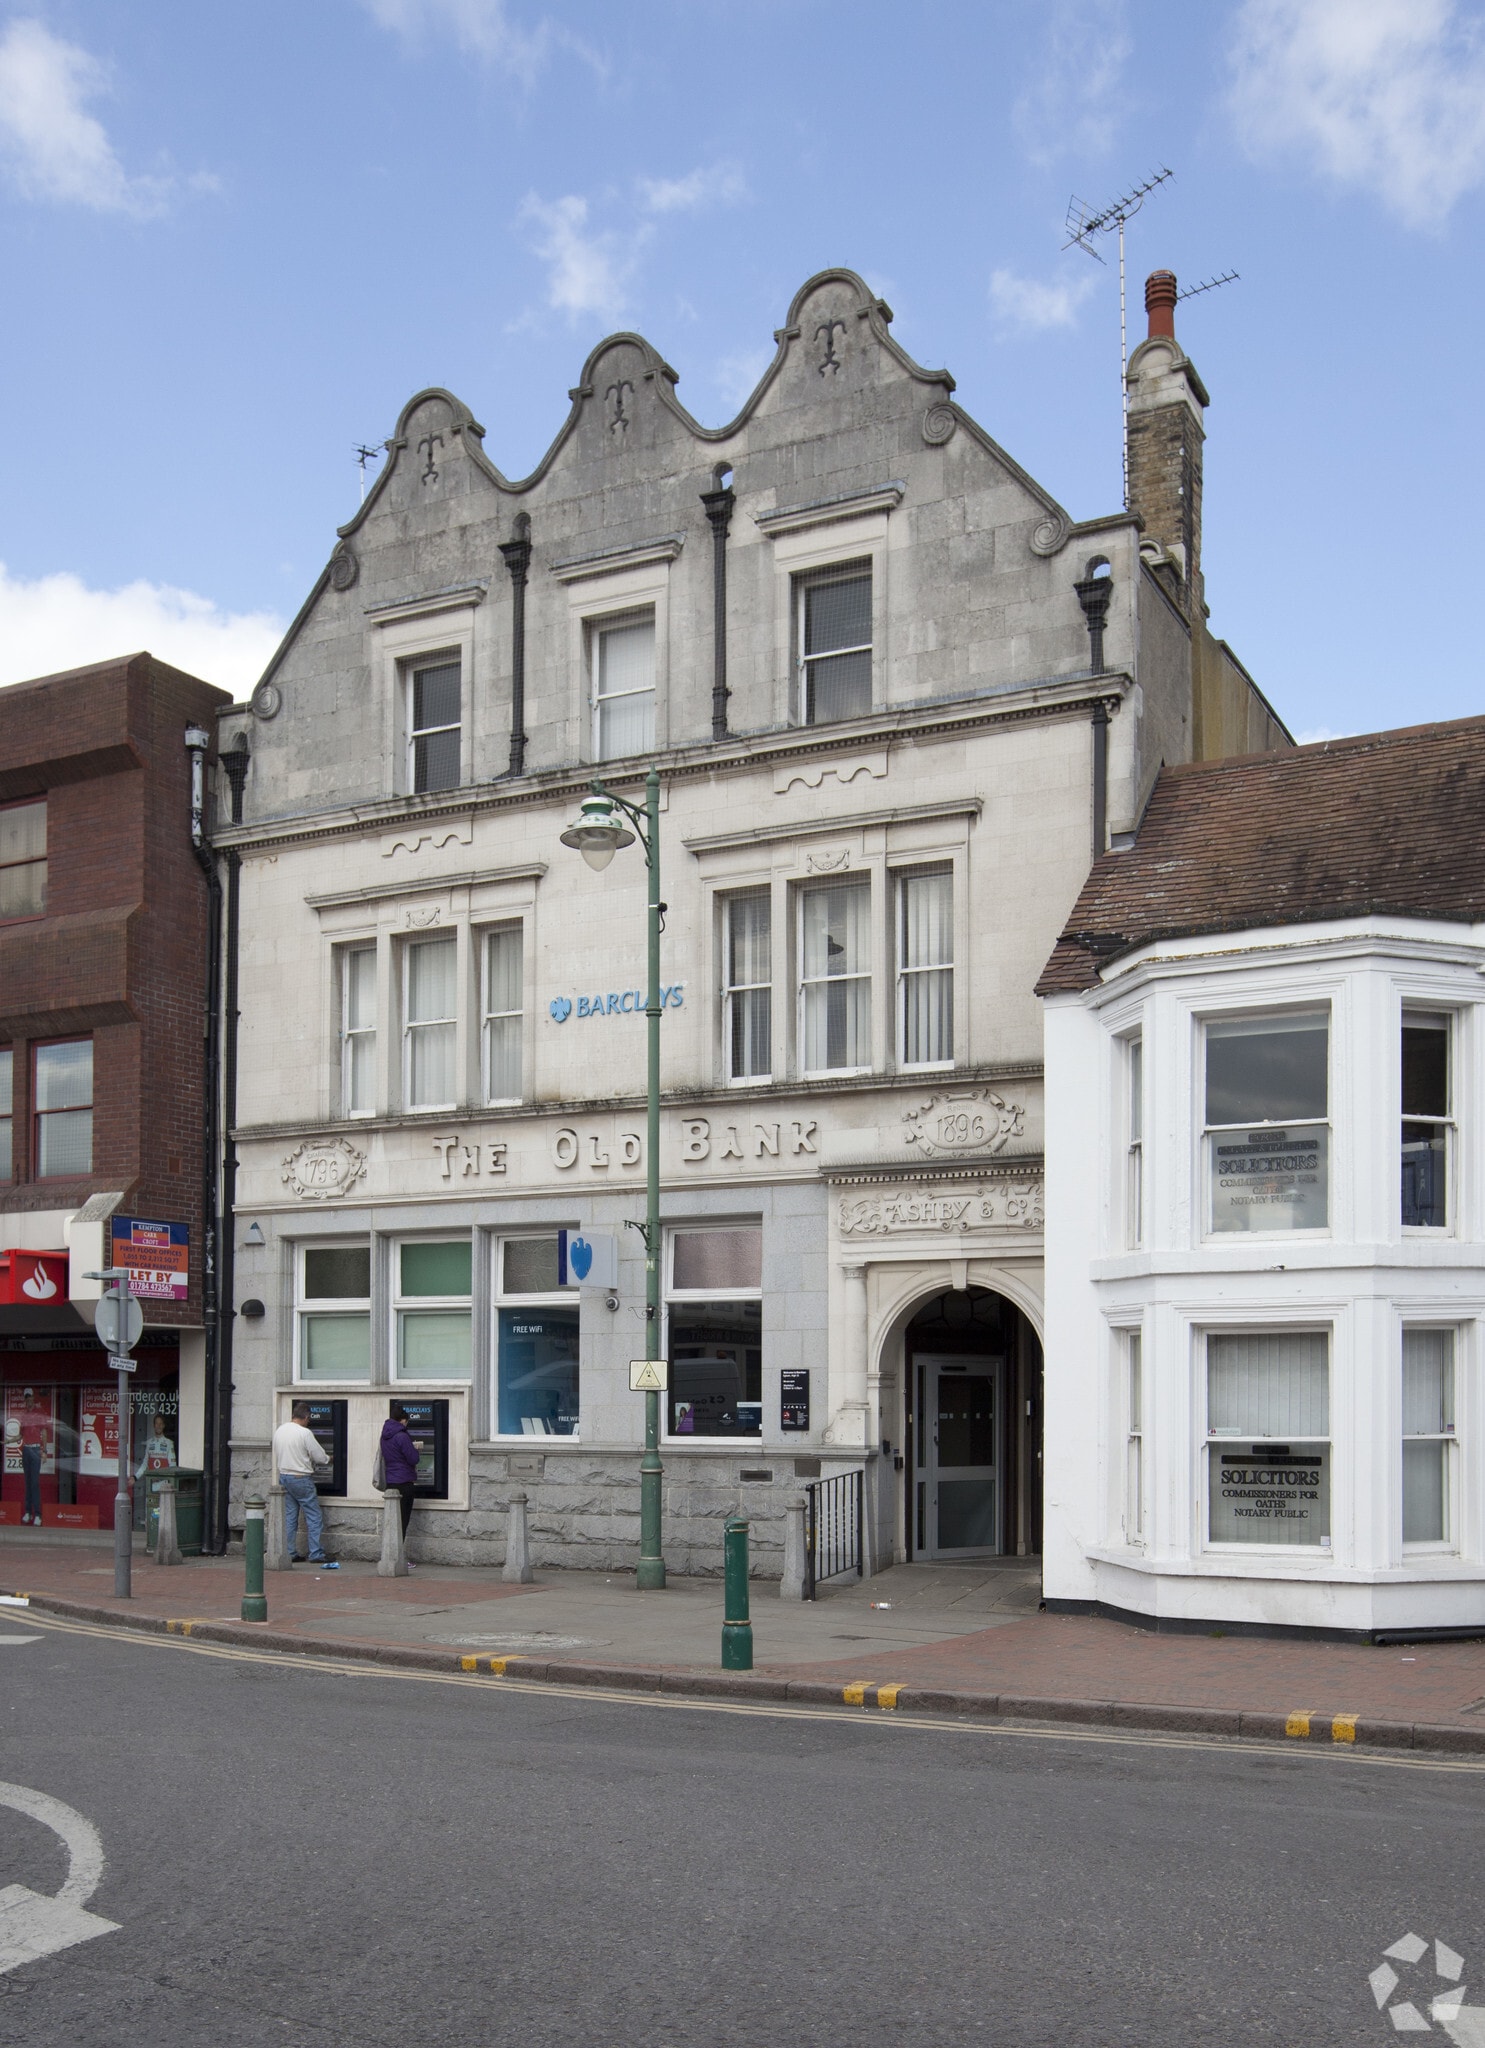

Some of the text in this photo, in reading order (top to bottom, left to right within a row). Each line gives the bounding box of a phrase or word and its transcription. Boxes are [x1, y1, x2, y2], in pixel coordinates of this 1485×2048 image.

[937, 1113, 985, 1143] 1896
[432, 1117, 818, 1178] THE OLD BANK
[1218, 1154, 1318, 1175] SOLICITORS
[304, 1158, 339, 1184] 1796
[1230, 1195, 1268, 1206] NOTARY
[885, 1200, 972, 1224] ASHBY
[980, 1201, 994, 1218] &
[138, 1224, 163, 1233] KEMPTON
[142, 1238, 159, 1246] CROFT
[138, 1246, 157, 1254] FLOOR
[159, 1248, 183, 1257] OFFICES
[152, 1263, 177, 1271] PARKING
[130, 1269, 173, 1283] LET BY
[129, 1281, 149, 1290] 01784
[513, 1325, 543, 1333] FREE WiFi
[120, 1359, 135, 1367] loading
[102, 1389, 179, 1402] sannder.co.uk
[137, 1402, 156, 1415] 765
[158, 1402, 177, 1415] 432
[104, 1430, 119, 1439] 123
[1221, 1470, 1320, 1486] SOLICITORS
[1222, 1489, 1319, 1500] COMMISSIONERS FOR
[1255, 1499, 1286, 1508] OATHS
[1234, 1508, 1309, 1519] NOTARY PUBLIC
